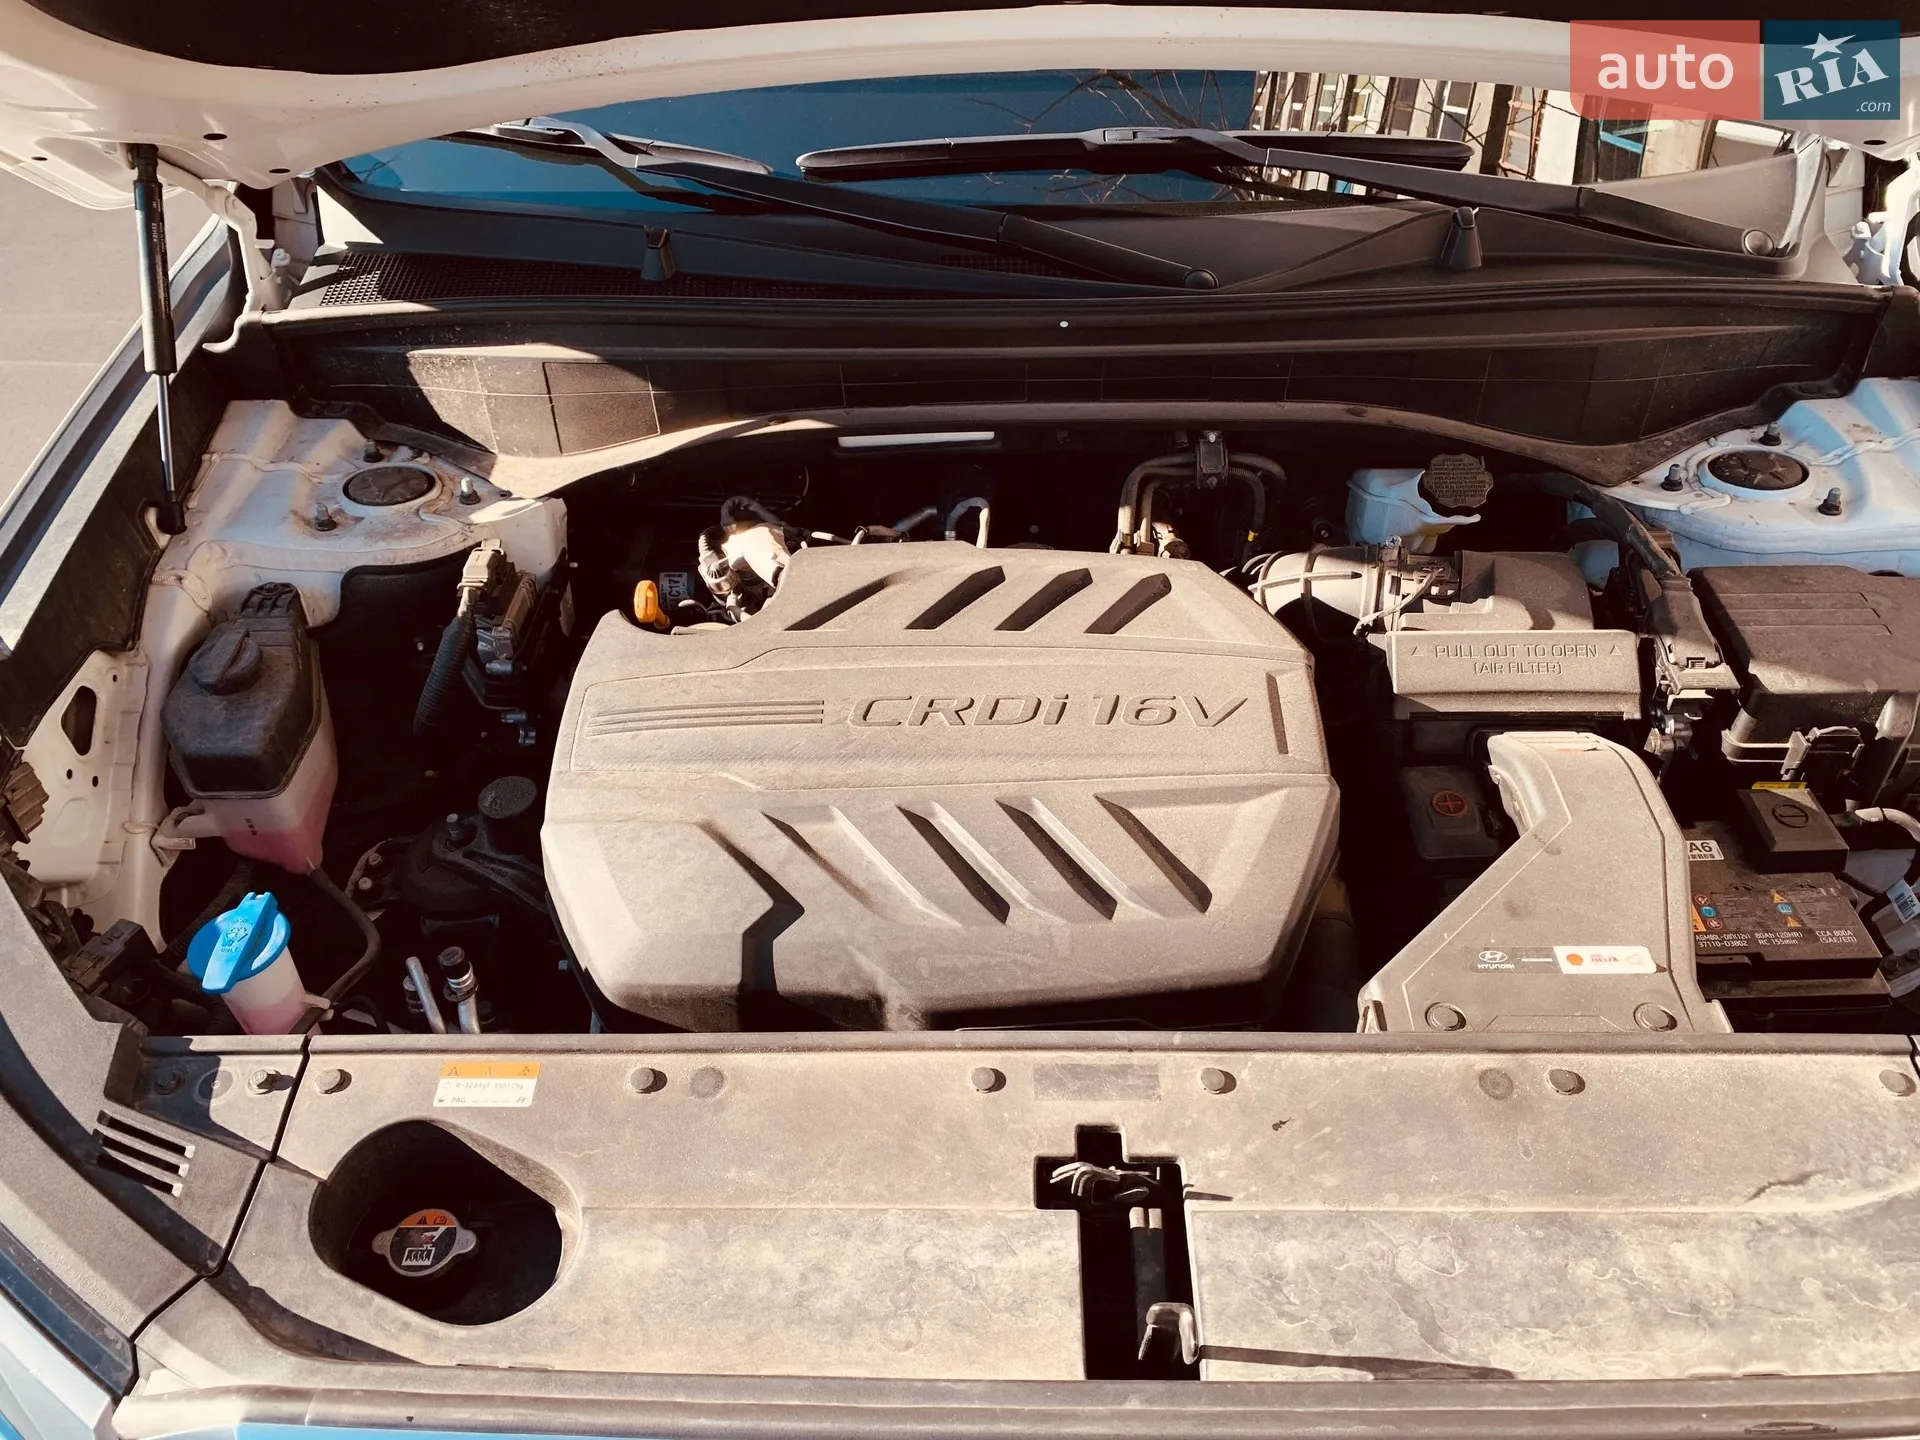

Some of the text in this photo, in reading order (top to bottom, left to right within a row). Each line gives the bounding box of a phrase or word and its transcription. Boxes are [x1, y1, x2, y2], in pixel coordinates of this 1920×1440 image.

[1435, 644, 1599, 659] PULL OUT TO OPEN
[1473, 661, 1562, 676] (AIR FILTER)
[847, 693, 1248, 728] CRDi 16V
[1689, 841, 1713, 853] A6
[1776, 931, 1804, 939] (20HR)
[1815, 930, 1833, 938] CCA
